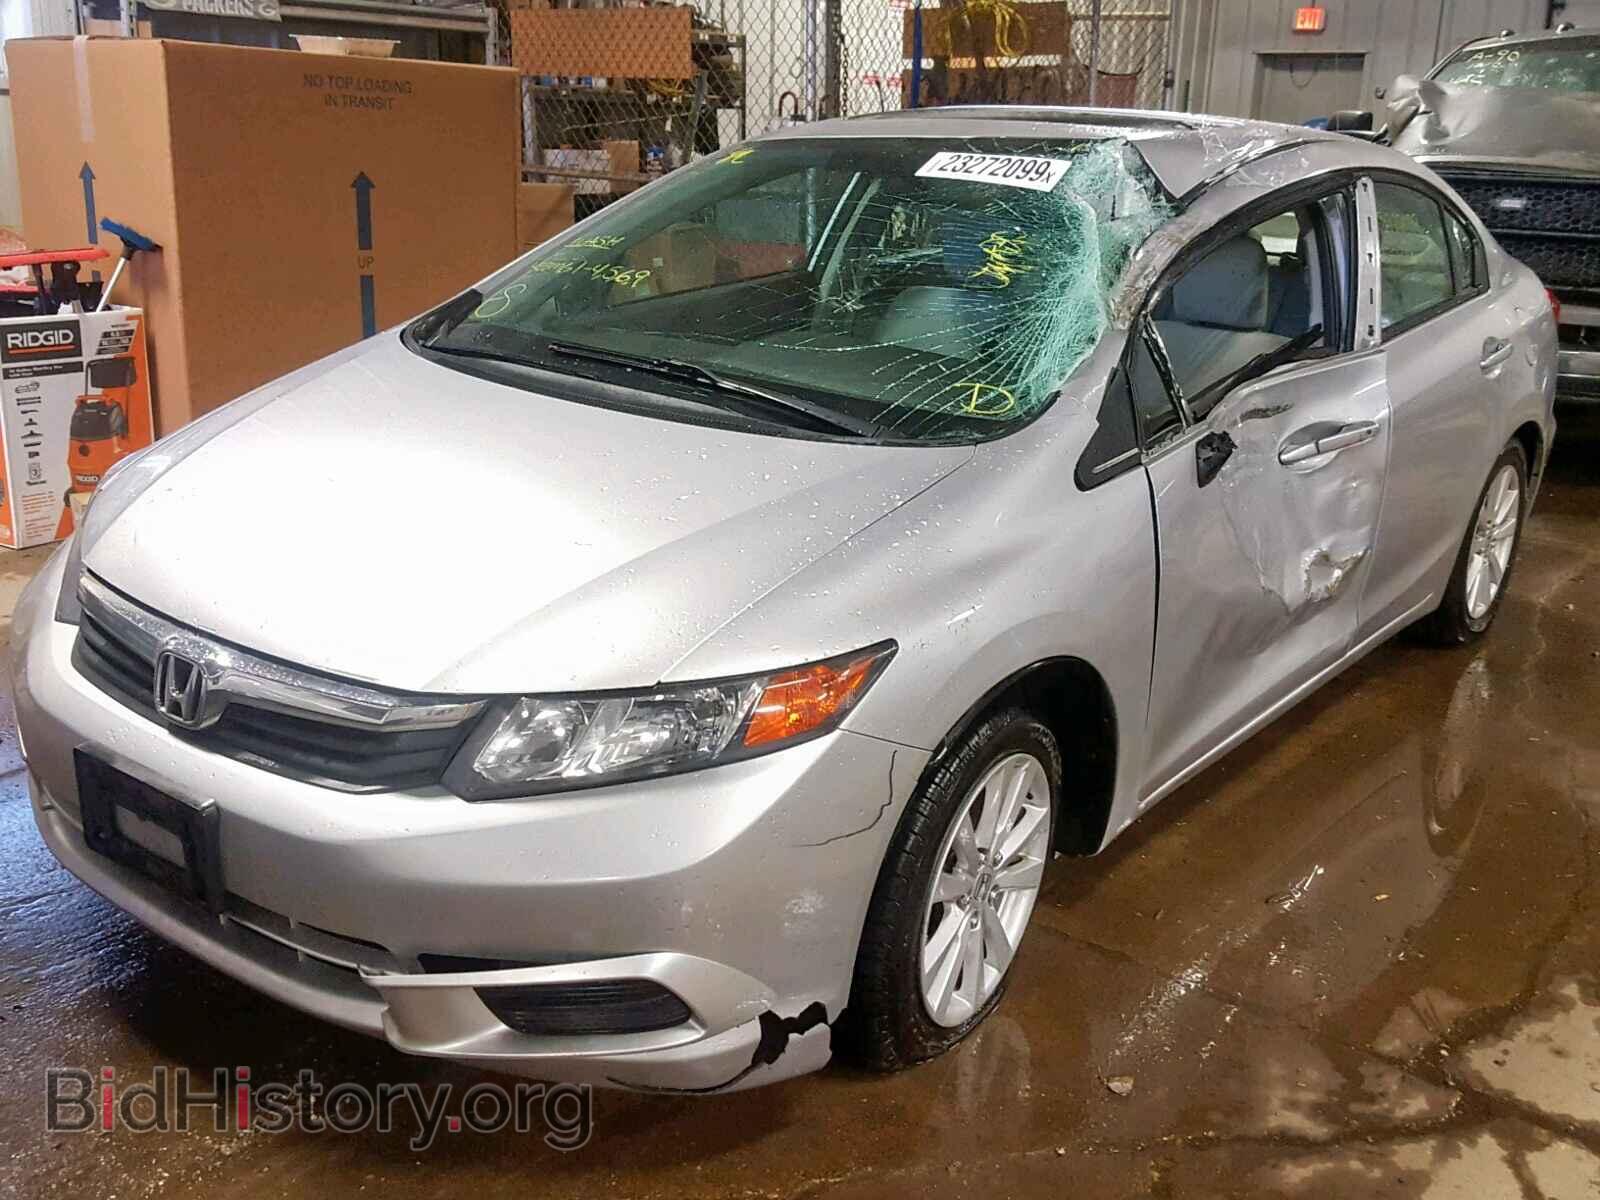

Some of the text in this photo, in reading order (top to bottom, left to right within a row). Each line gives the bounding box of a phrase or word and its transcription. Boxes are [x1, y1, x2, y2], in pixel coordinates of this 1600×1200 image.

[1297, 9, 1323, 29] EXIT
[303, 74, 413, 95] NO TOP LOADING
[324, 94, 395, 110] IN TRANSIT
[358, 255, 375, 269] UP
[6, 329, 75, 349] RIDGID
